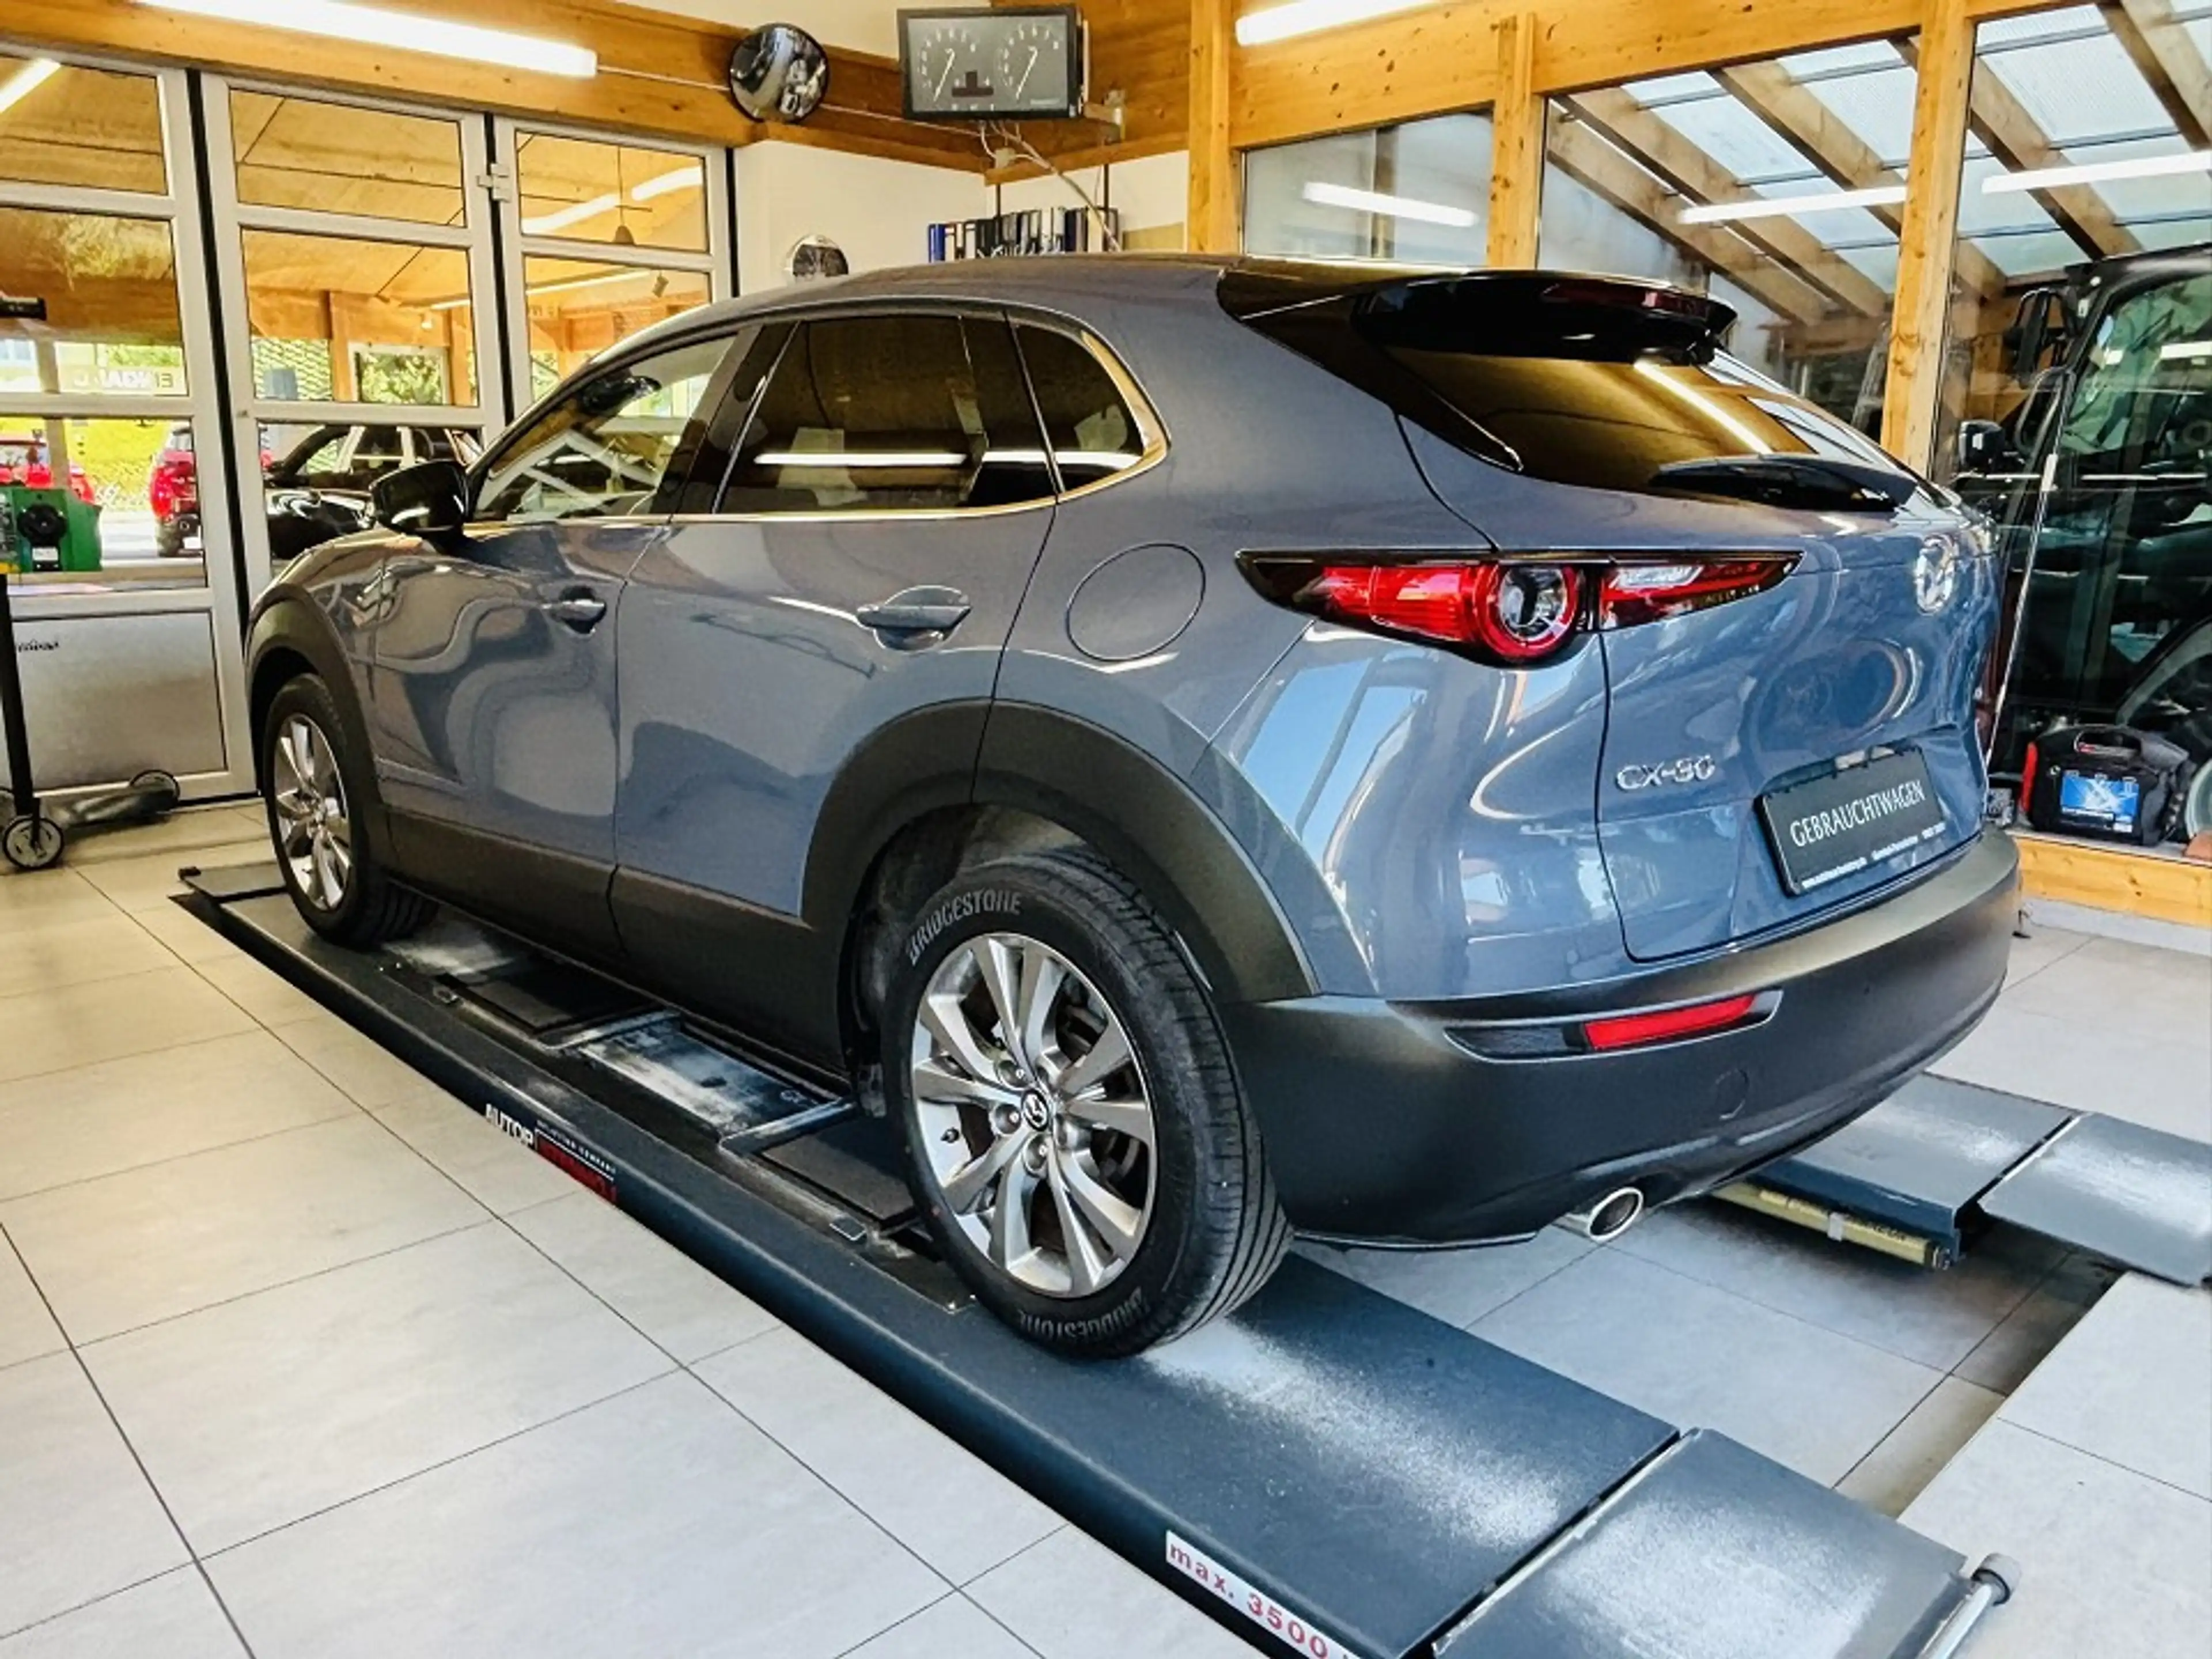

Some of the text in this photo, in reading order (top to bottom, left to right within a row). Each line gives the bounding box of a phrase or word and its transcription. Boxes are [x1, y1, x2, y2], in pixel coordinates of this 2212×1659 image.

[1616, 755, 1715, 790] CX-30
[1790, 780, 1926, 847] GEBRAUCHTWAGEN
[908, 888, 1021, 966] BRIDGESTONE
[1169, 1543, 1328, 1658] max. 3500
